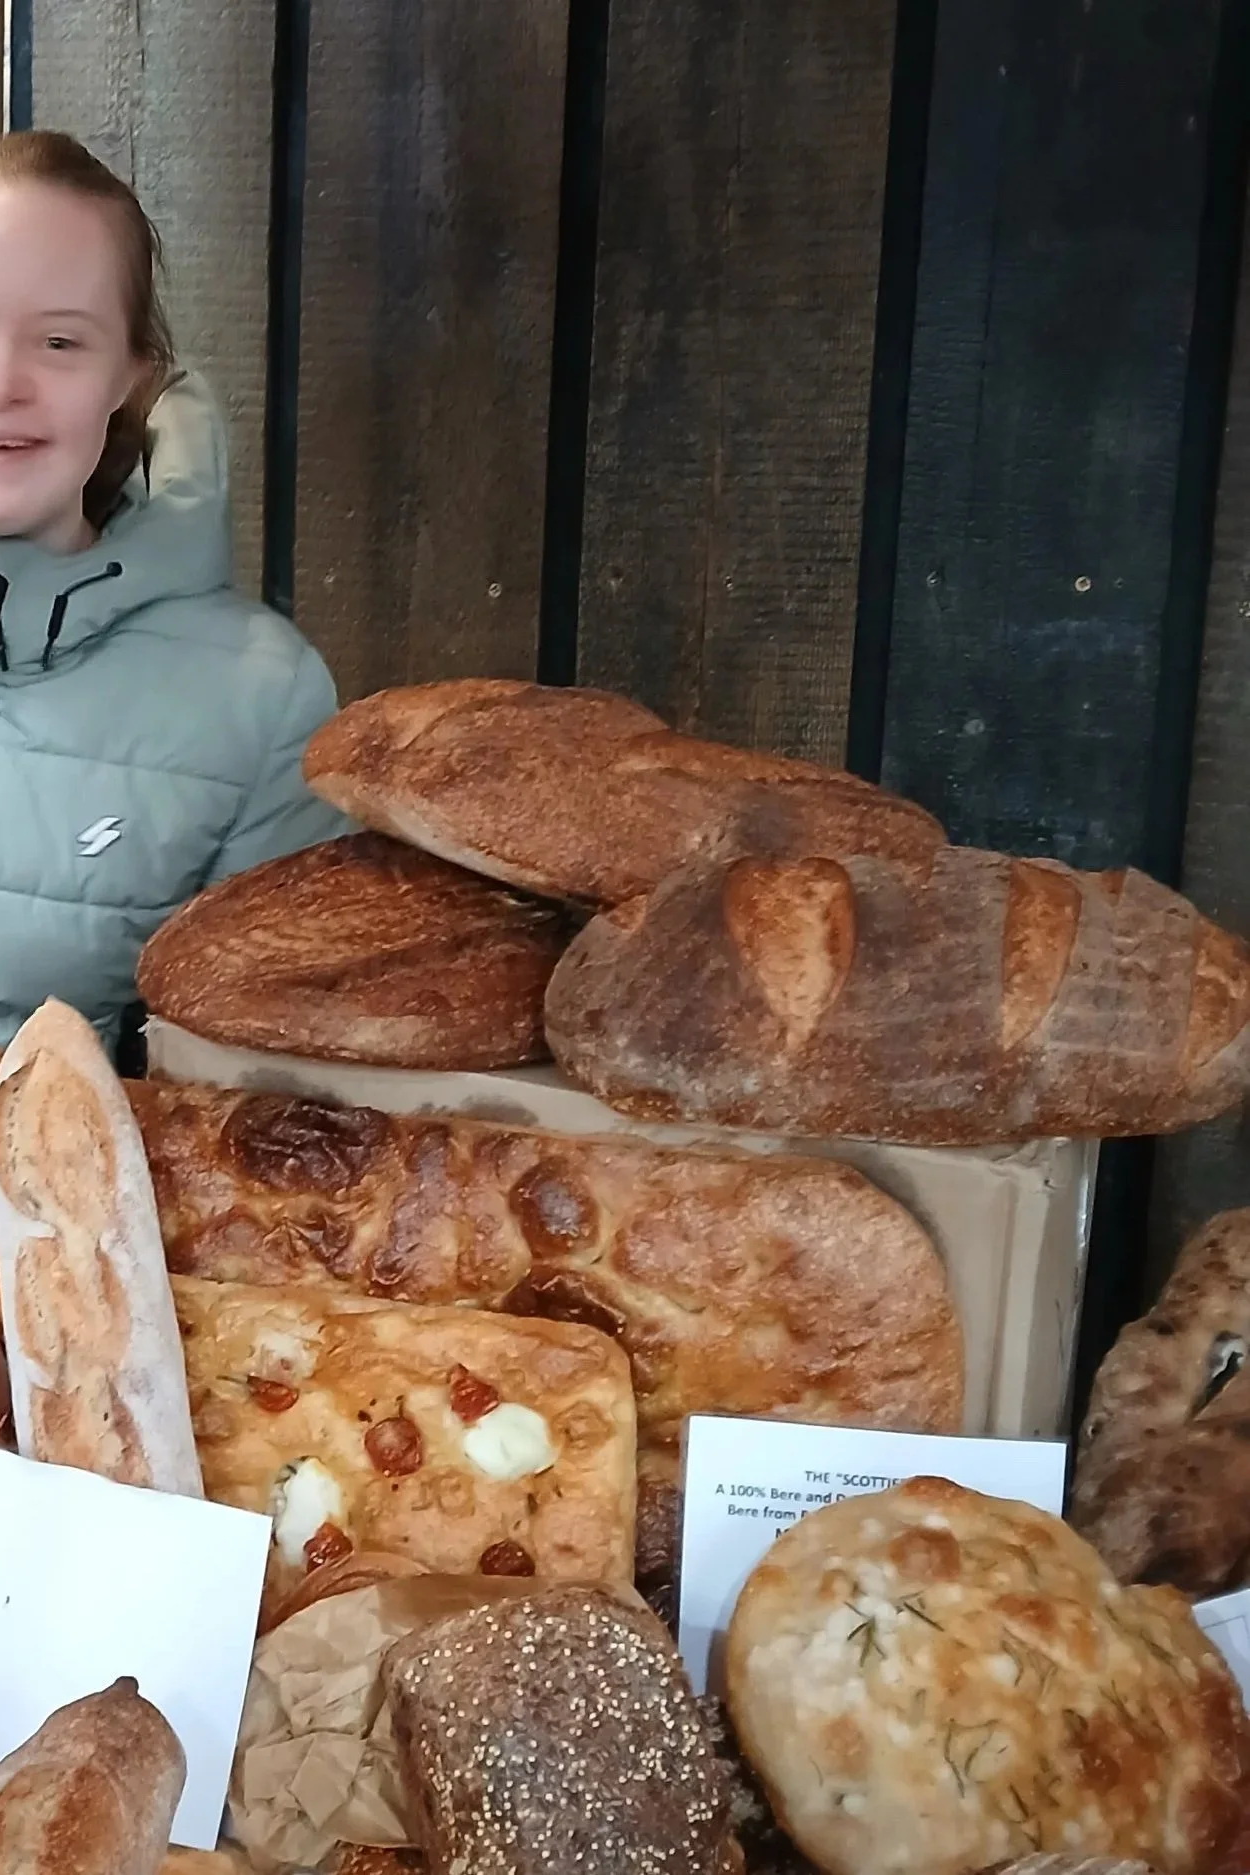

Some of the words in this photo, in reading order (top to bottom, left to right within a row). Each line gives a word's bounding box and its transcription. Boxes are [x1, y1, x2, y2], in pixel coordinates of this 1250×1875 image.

[805, 1470, 830, 1484] THE
[715, 1483, 725, 1495] A
[729, 1484, 767, 1498] 100%
[770, 1488, 802, 1501] Bere
[806, 1492, 832, 1504] and
[727, 1504, 759, 1518] Bere
[763, 1506, 797, 1520] from
